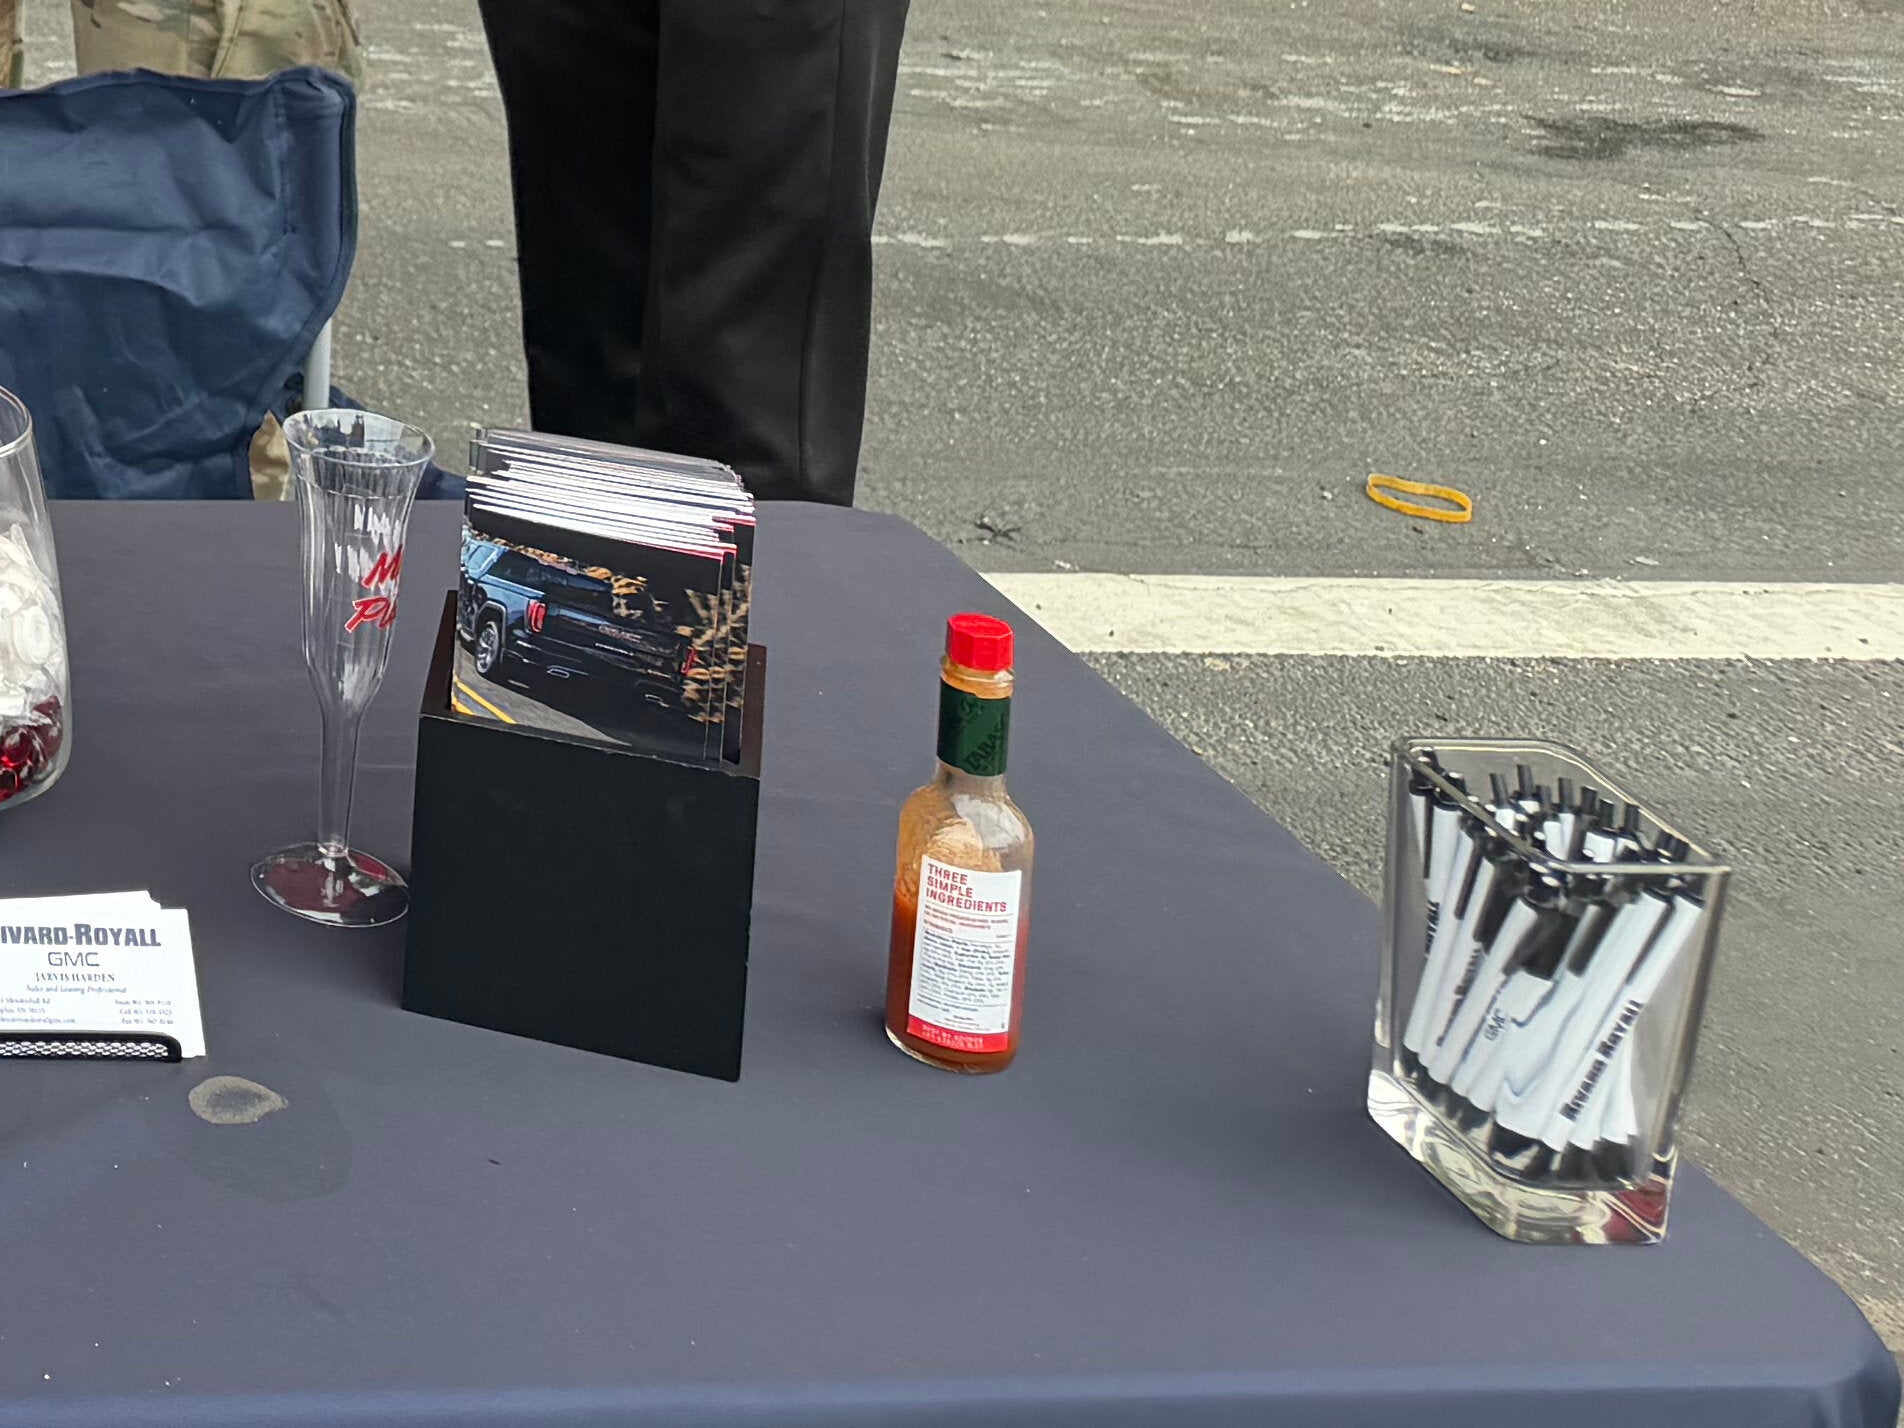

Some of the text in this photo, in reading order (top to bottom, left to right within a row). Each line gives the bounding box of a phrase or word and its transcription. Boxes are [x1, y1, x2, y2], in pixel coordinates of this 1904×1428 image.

[927, 863, 968, 886] THREE
[926, 875, 974, 899] SIMPLE
[925, 887, 1008, 912] INGREDIENTS
[47, 951, 100, 967] GMC
